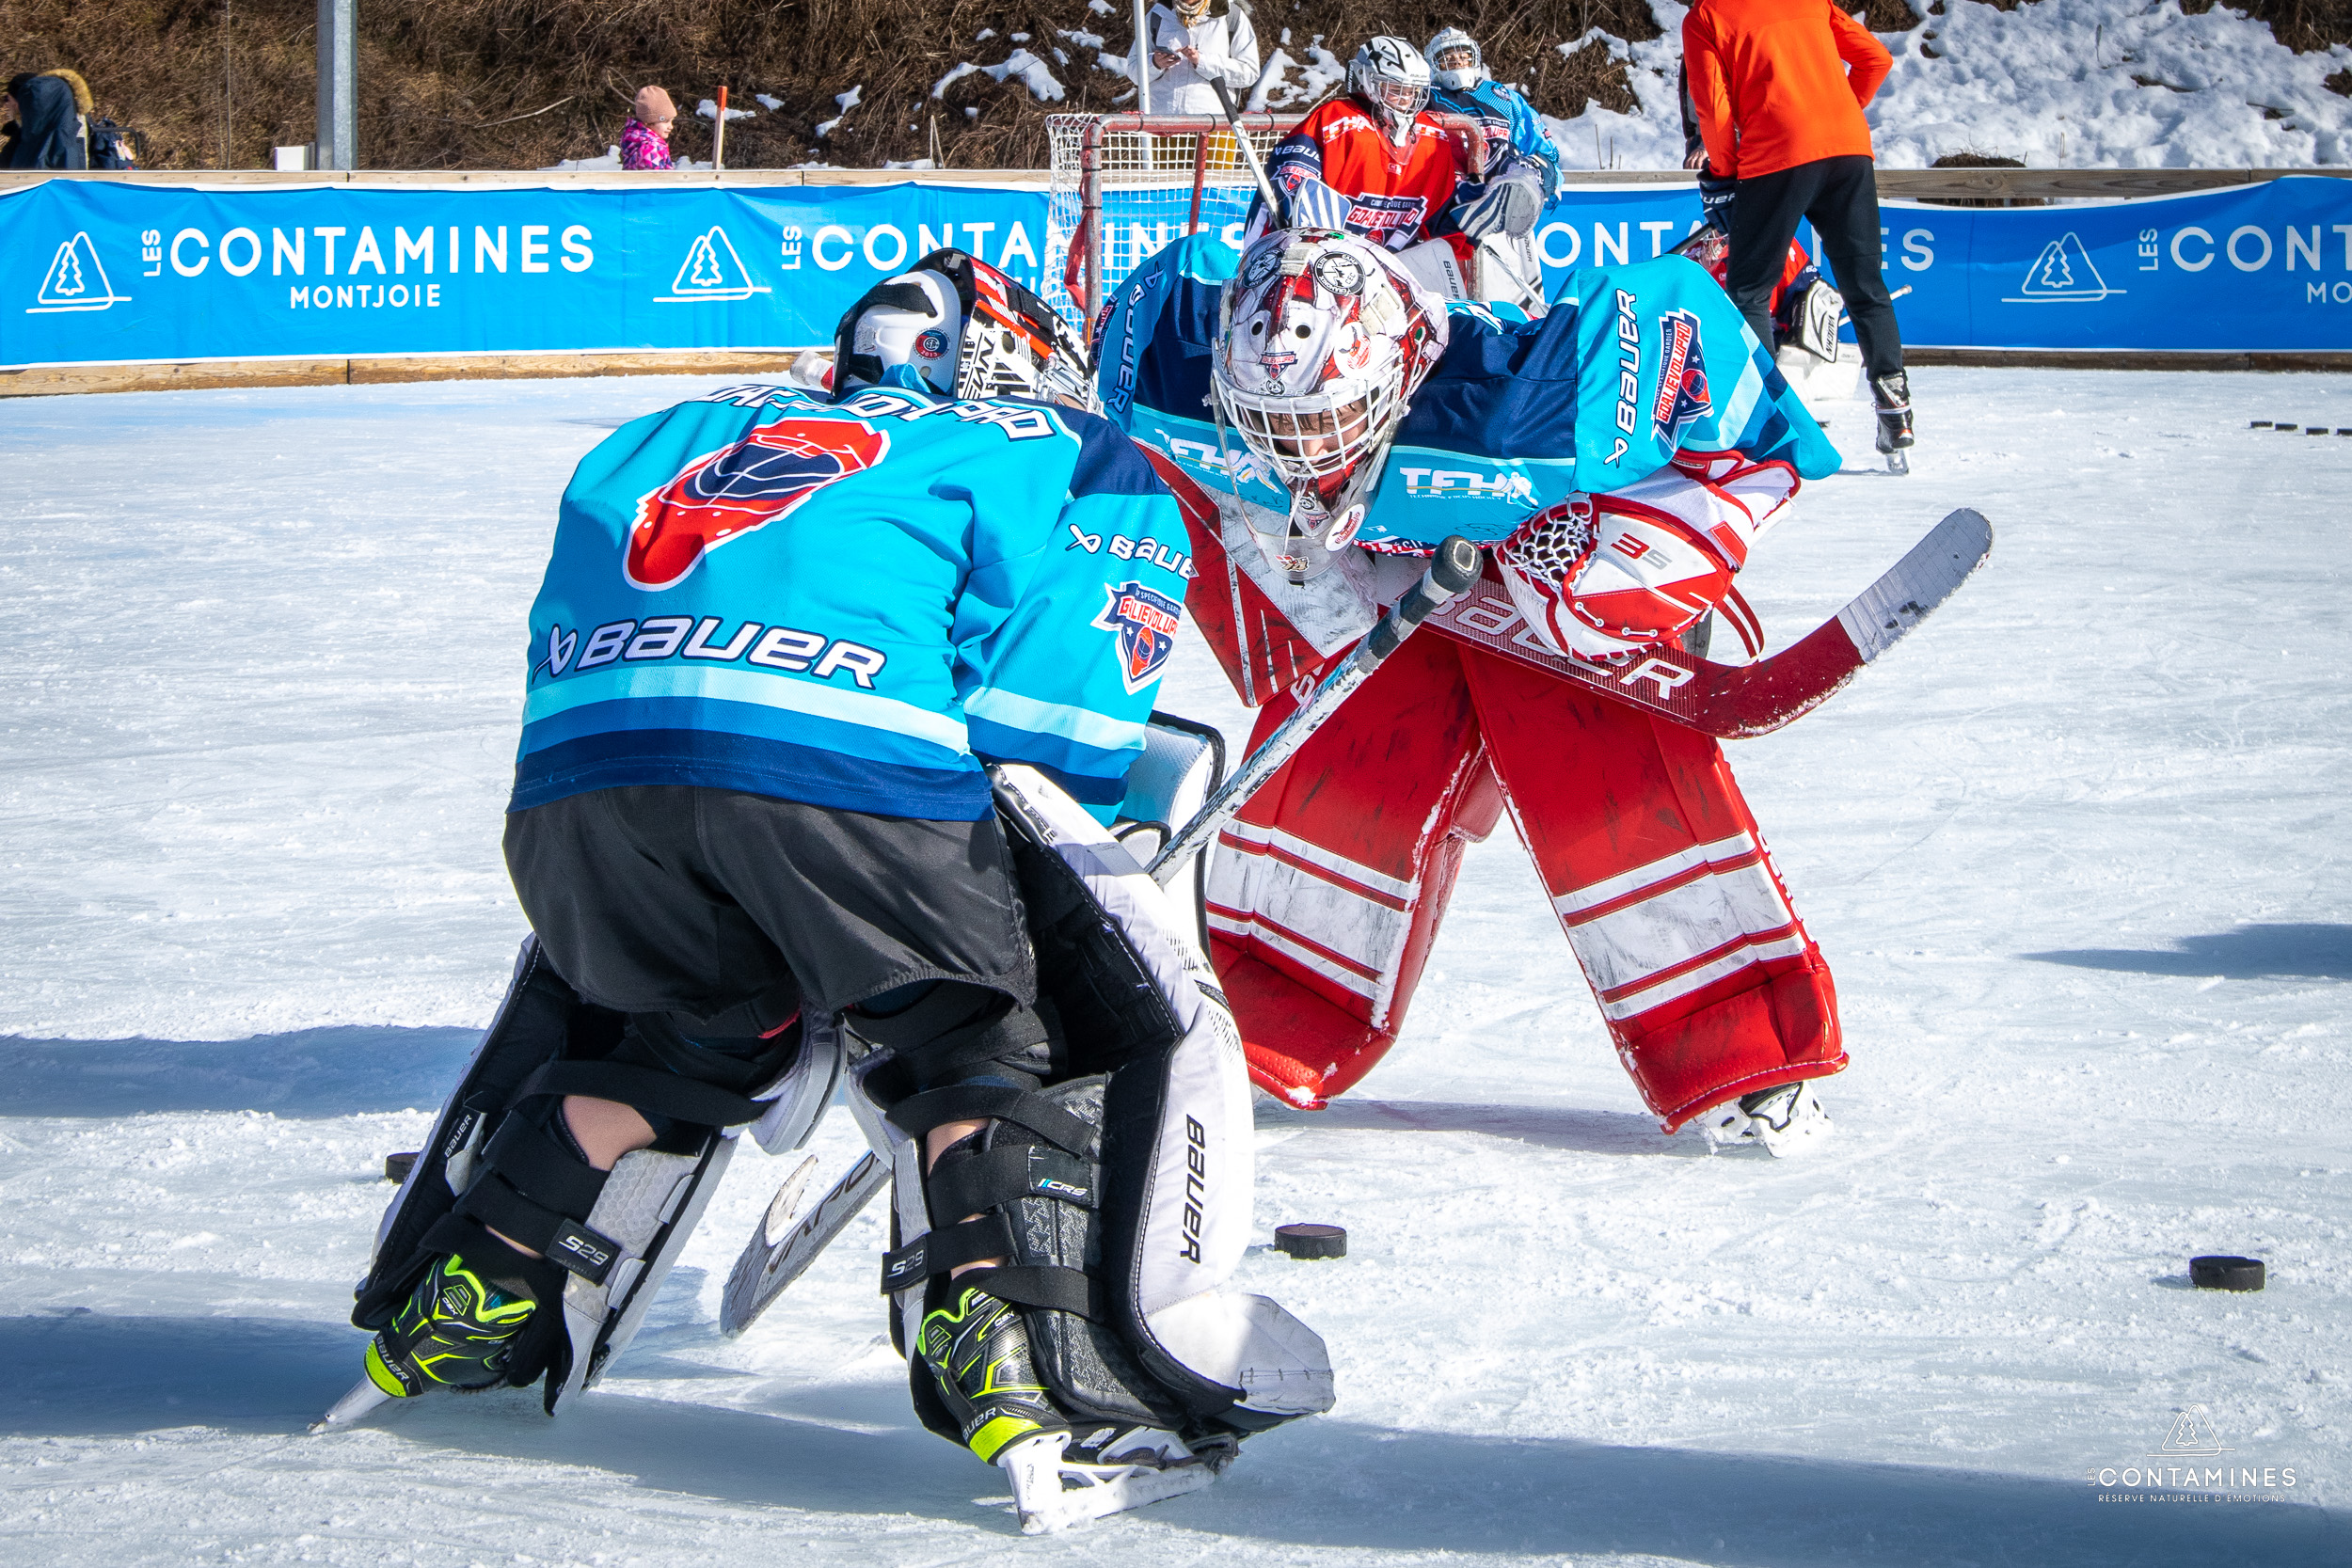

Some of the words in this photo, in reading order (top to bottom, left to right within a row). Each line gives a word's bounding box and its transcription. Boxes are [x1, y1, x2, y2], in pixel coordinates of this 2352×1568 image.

[142, 229, 162, 277] LES
[169, 225, 594, 277] CONTAMINES
[782, 226, 802, 270] LES
[2138, 228, 2159, 271] LES
[290, 284, 441, 309] MONTJOIE
[1344, 272, 1357, 285] CEC
[1657, 321, 1692, 422] GOALIEVOLUPRO
[1107, 534, 1193, 581] BAUE
[558, 1234, 610, 1267] S29
[887, 1248, 925, 1278] S29
